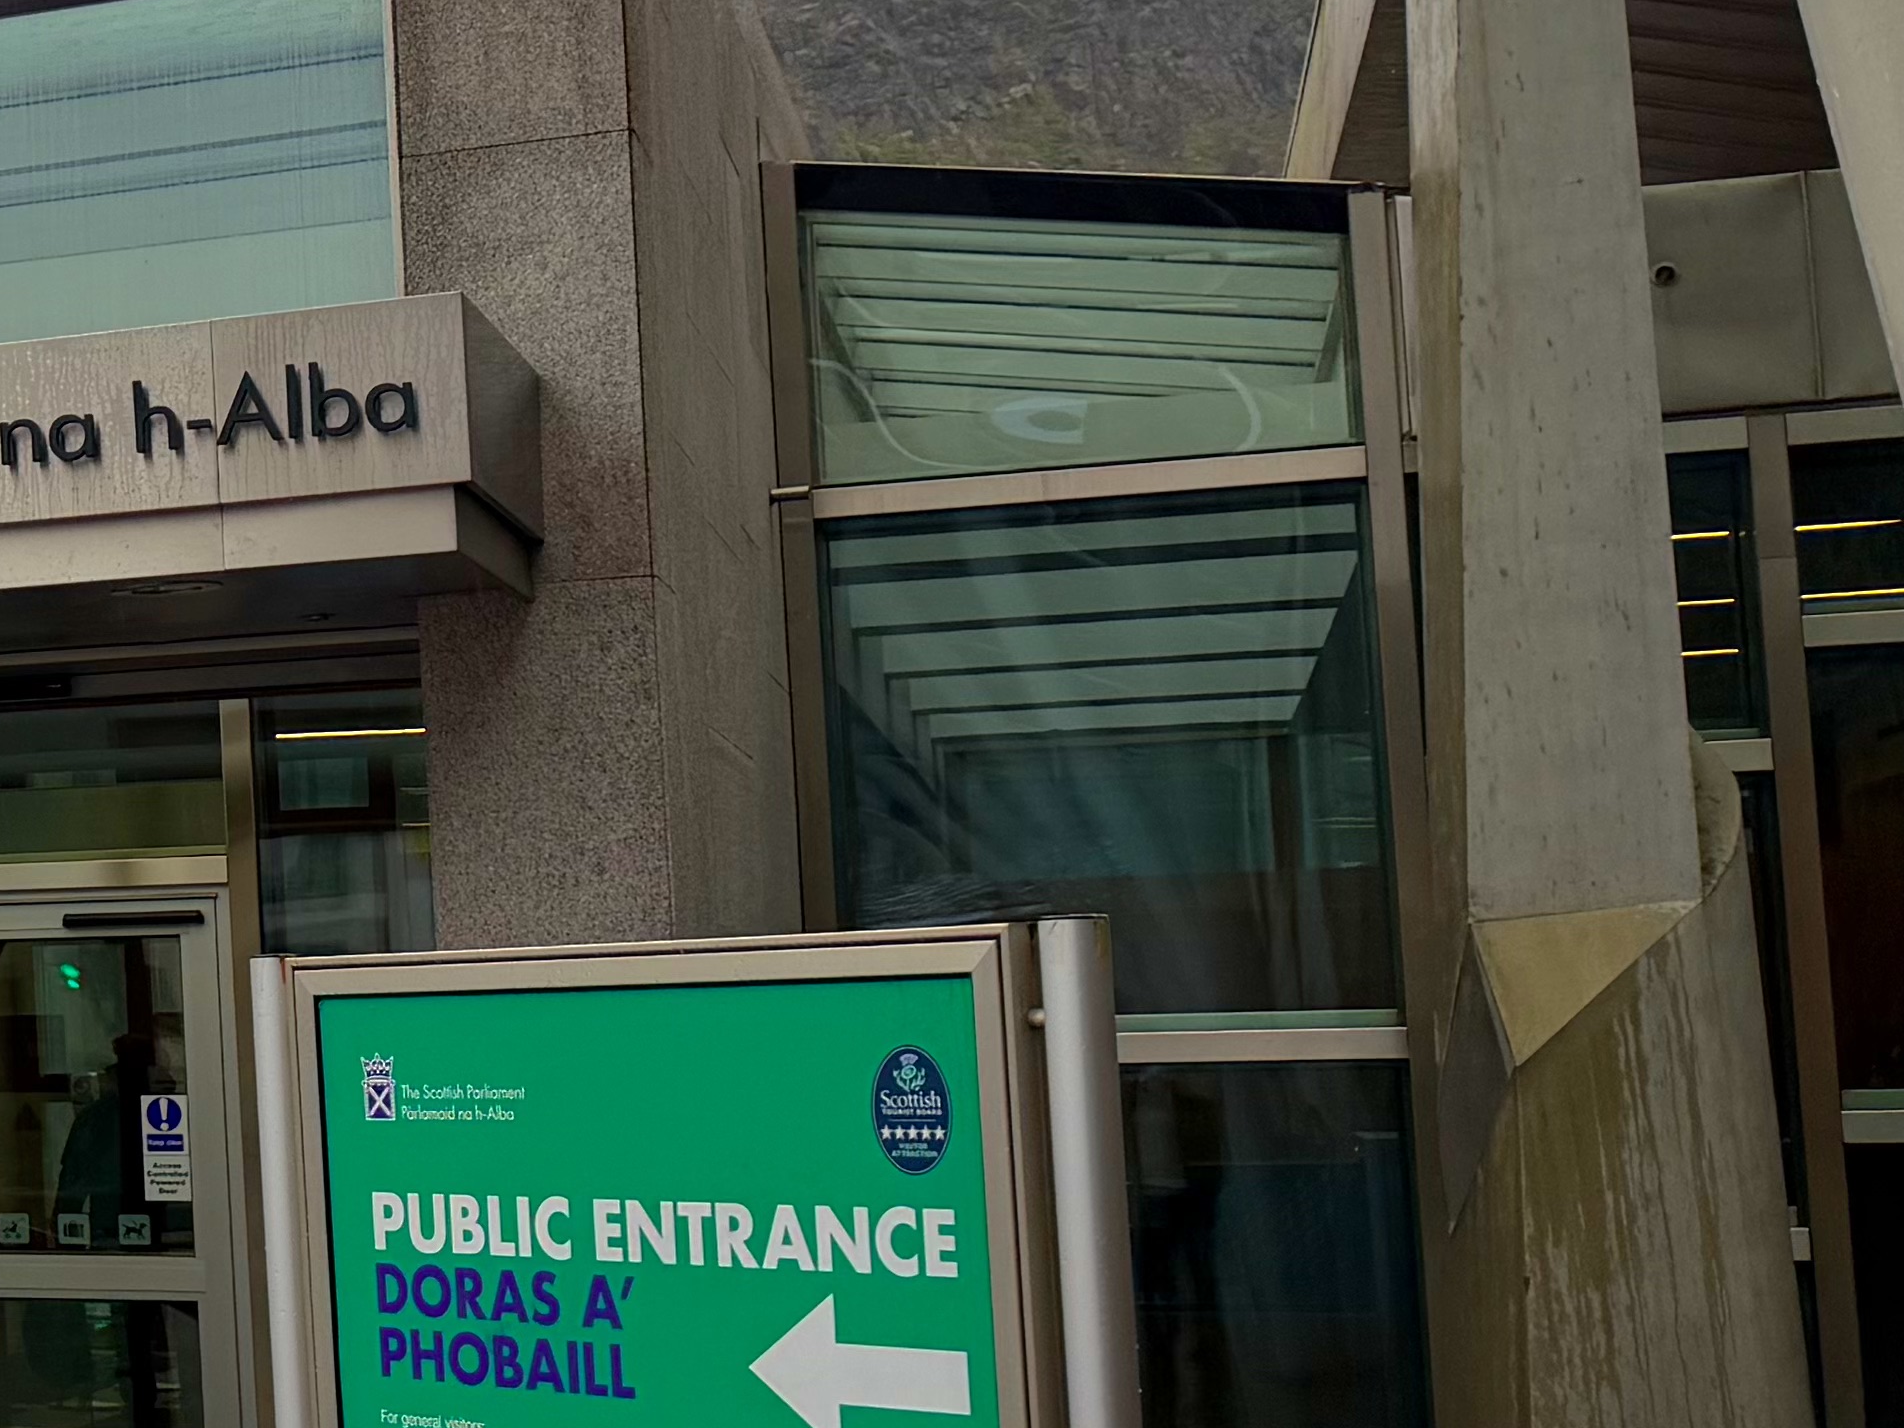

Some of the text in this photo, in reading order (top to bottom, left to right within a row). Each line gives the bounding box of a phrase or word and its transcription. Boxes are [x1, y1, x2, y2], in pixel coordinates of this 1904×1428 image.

[0, 411, 98, 467] na
[133, 362, 419, 454] h-Alba
[401, 1084, 525, 1100] The Scottish Parliament
[458, 1110, 472, 1120] na
[475, 1105, 514, 1120] h-Alba
[880, 1090, 941, 1108] Scottish
[372, 1192, 959, 1278] PUBLIC ENTRANCE
[375, 1262, 561, 1326] DORAS
[379, 1326, 636, 1399] PHOBAILL
[381, 1409, 398, 1423] For
[401, 1414, 441, 1428] general
